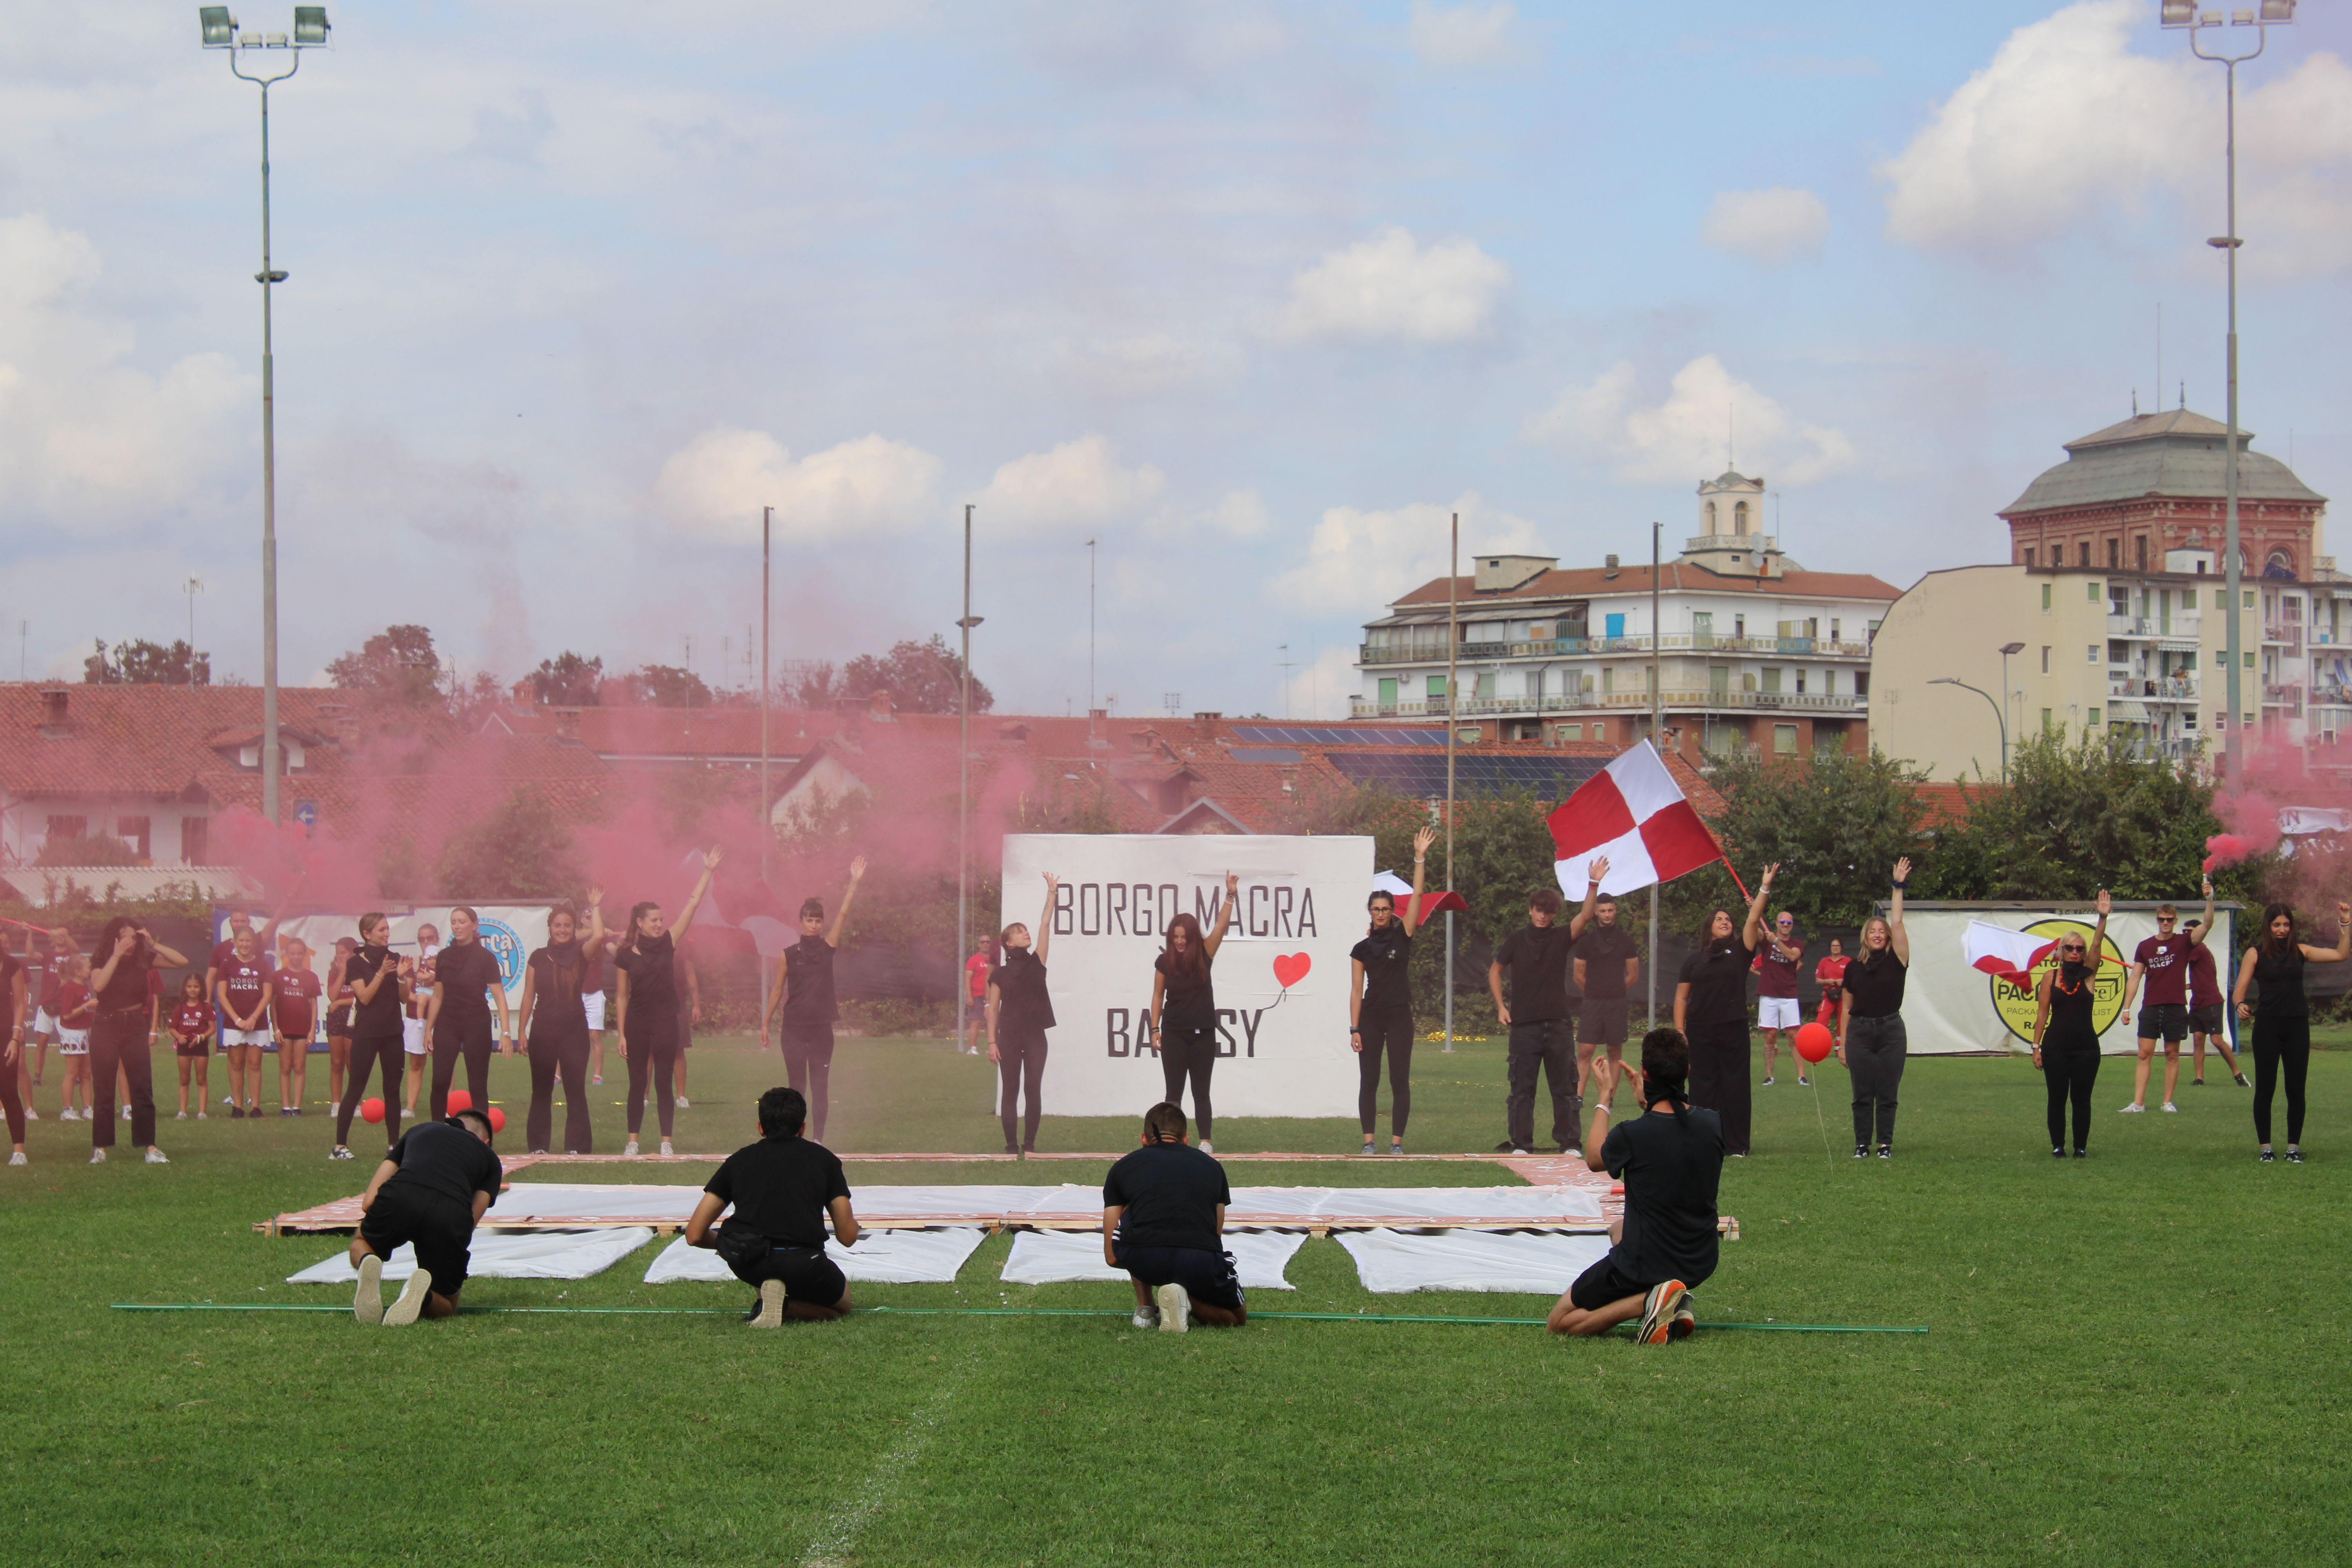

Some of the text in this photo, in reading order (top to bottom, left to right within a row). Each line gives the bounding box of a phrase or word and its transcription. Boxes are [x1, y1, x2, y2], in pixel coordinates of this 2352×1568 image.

[480, 918, 512, 933] LTURALE
[1054, 882, 1317, 938] BORGO MACRA
[1107, 1008, 1263, 1058] BASY
